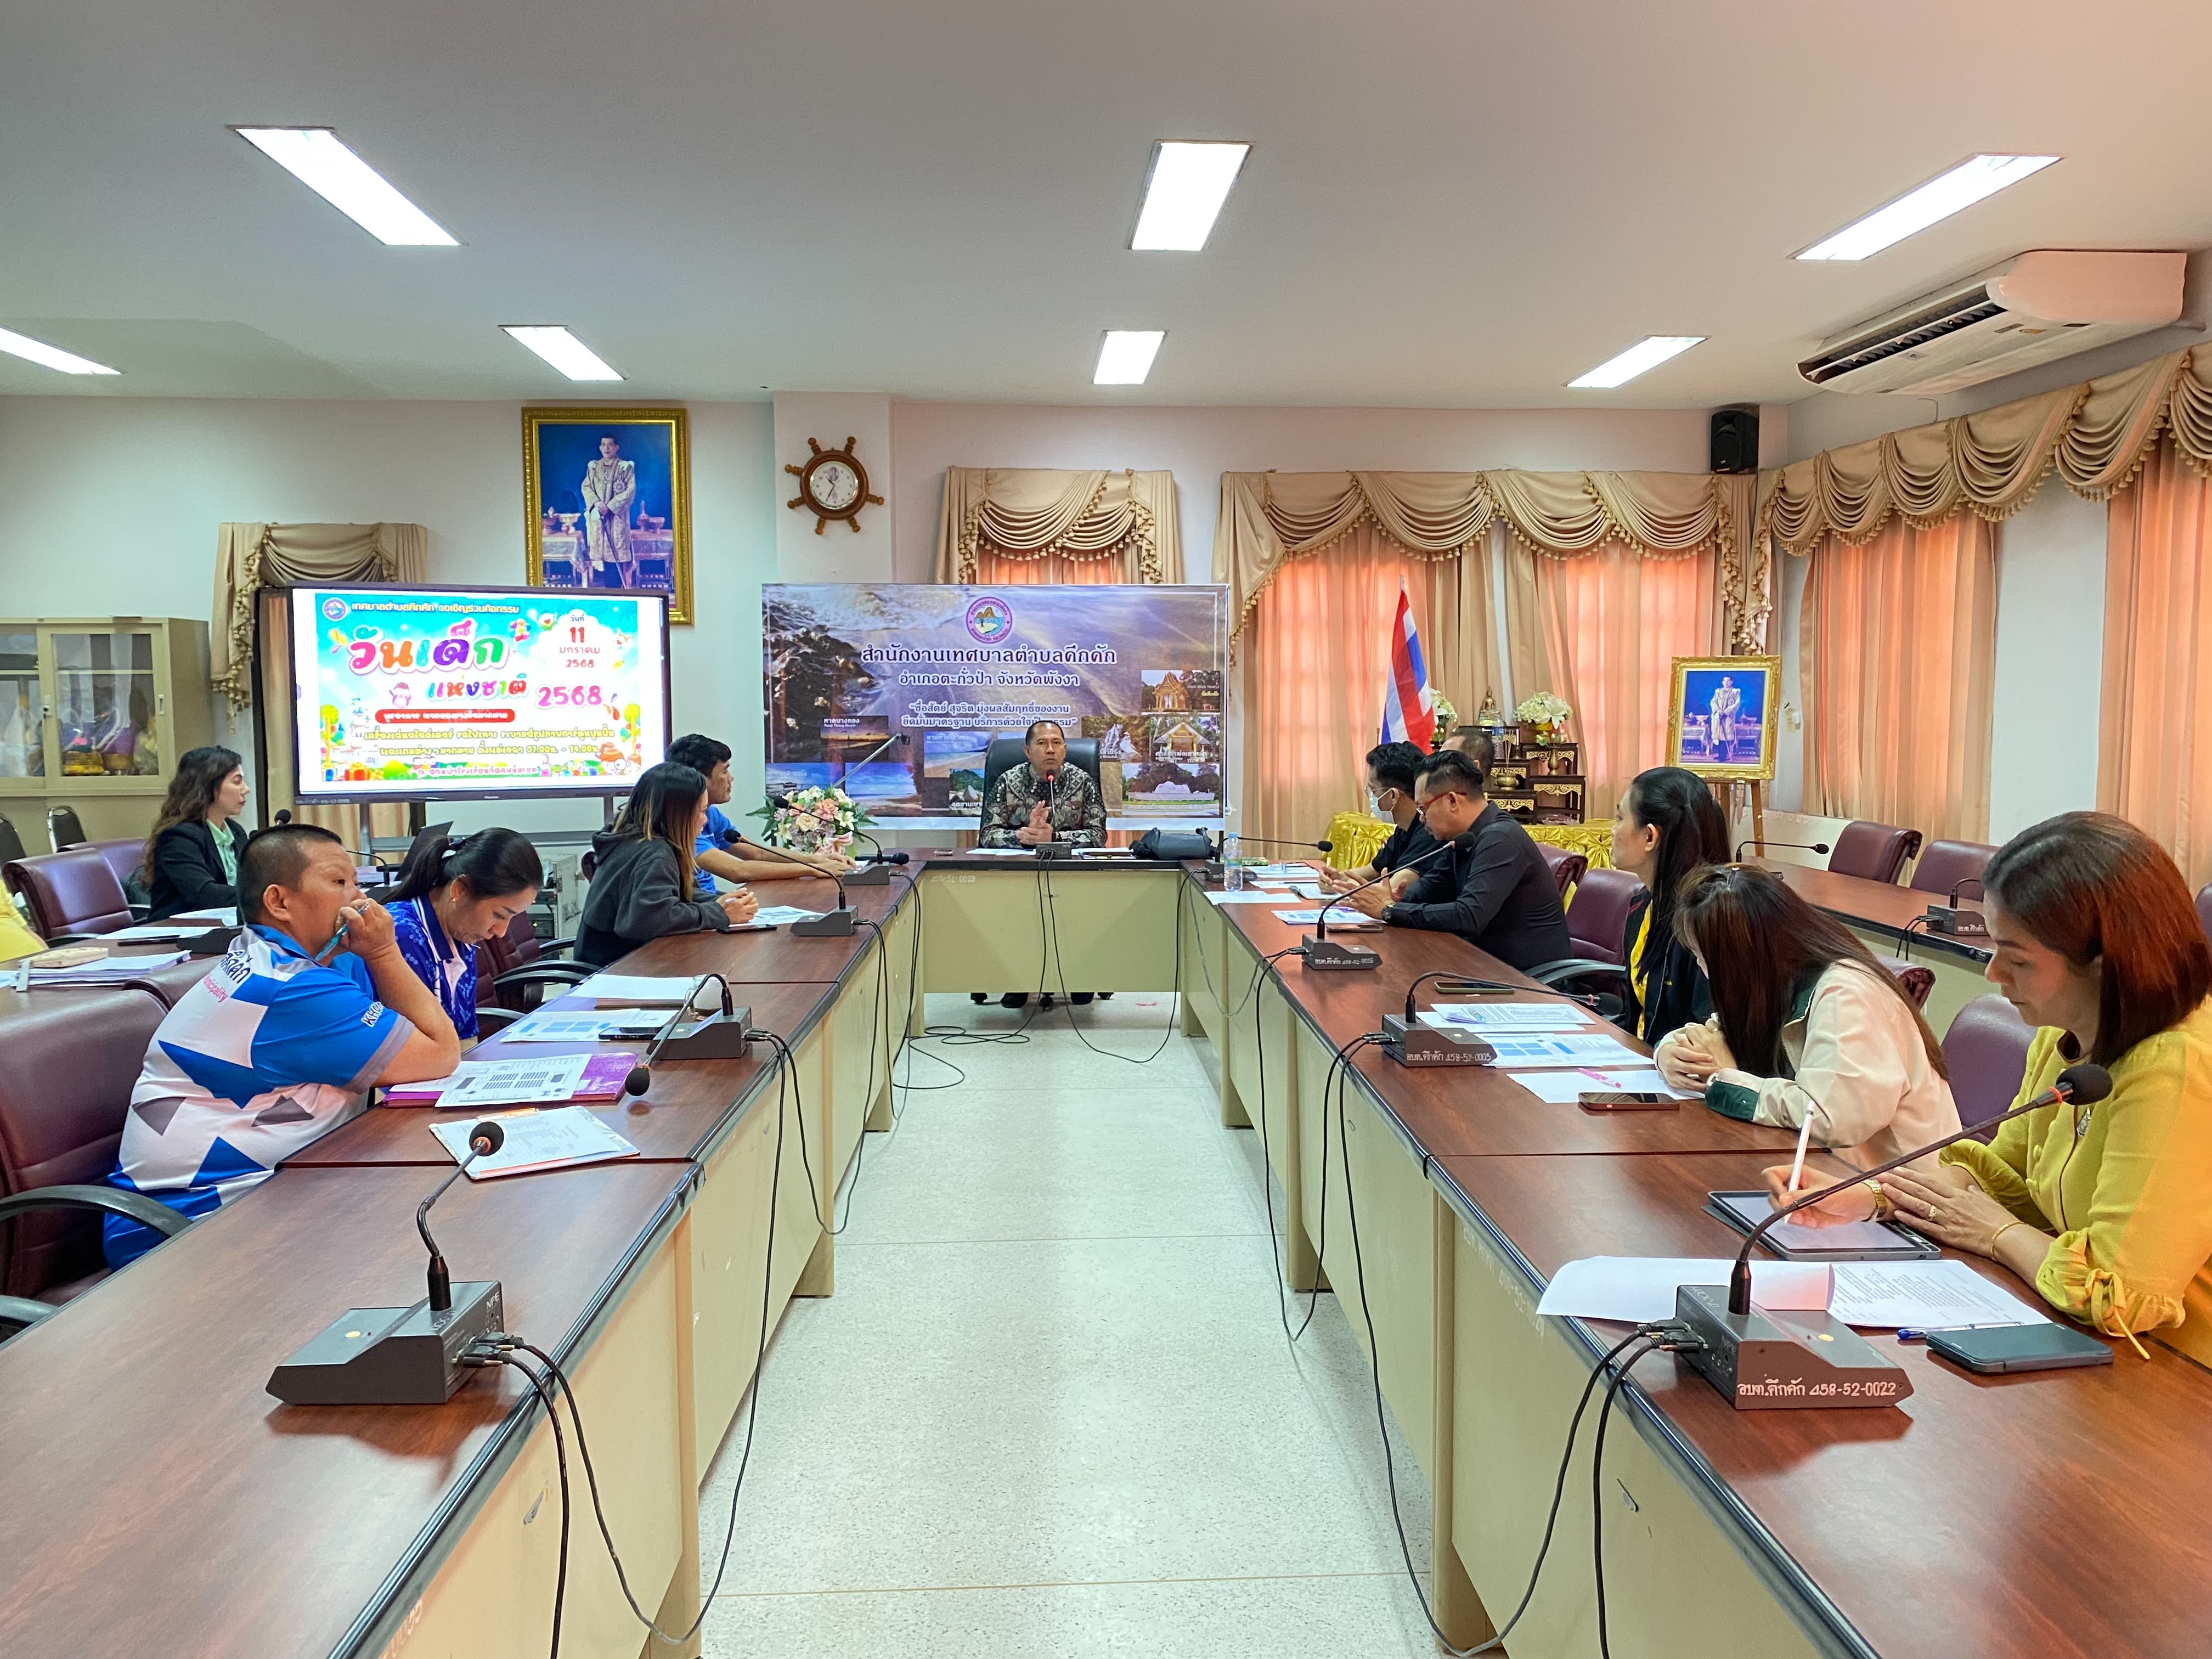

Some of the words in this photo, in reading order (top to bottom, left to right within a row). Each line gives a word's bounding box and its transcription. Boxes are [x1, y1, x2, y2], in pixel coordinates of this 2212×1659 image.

[352, 601, 435, 612] เทศบาลตำบลคึกคัก
[438, 601, 519, 613] ขอเชิญร่วมกิจกรรม
[570, 613, 585, 622] วันที่
[569, 627, 585, 642] 11
[349, 619, 504, 670] วันเด็ก
[558, 646, 601, 654] มกราคม
[862, 645, 1116, 664] สำนักงานเทศบาลตำบลคึกคัก
[566, 659, 595, 668] 2568
[900, 667, 992, 686] อำเภอตะกั่วป่า
[997, 670, 1079, 686] จังหวัดพังงา
[427, 673, 527, 697] แห่งชาติ
[538, 685, 603, 707] 2568
[950, 703, 974, 714] สุจริต
[902, 714, 970, 727] ยึดมั่นมาตรฐาน
[1737, 1376, 1805, 1396] อบต.คึกคัก
[1809, 1381, 1896, 1396] 458-52-0022
